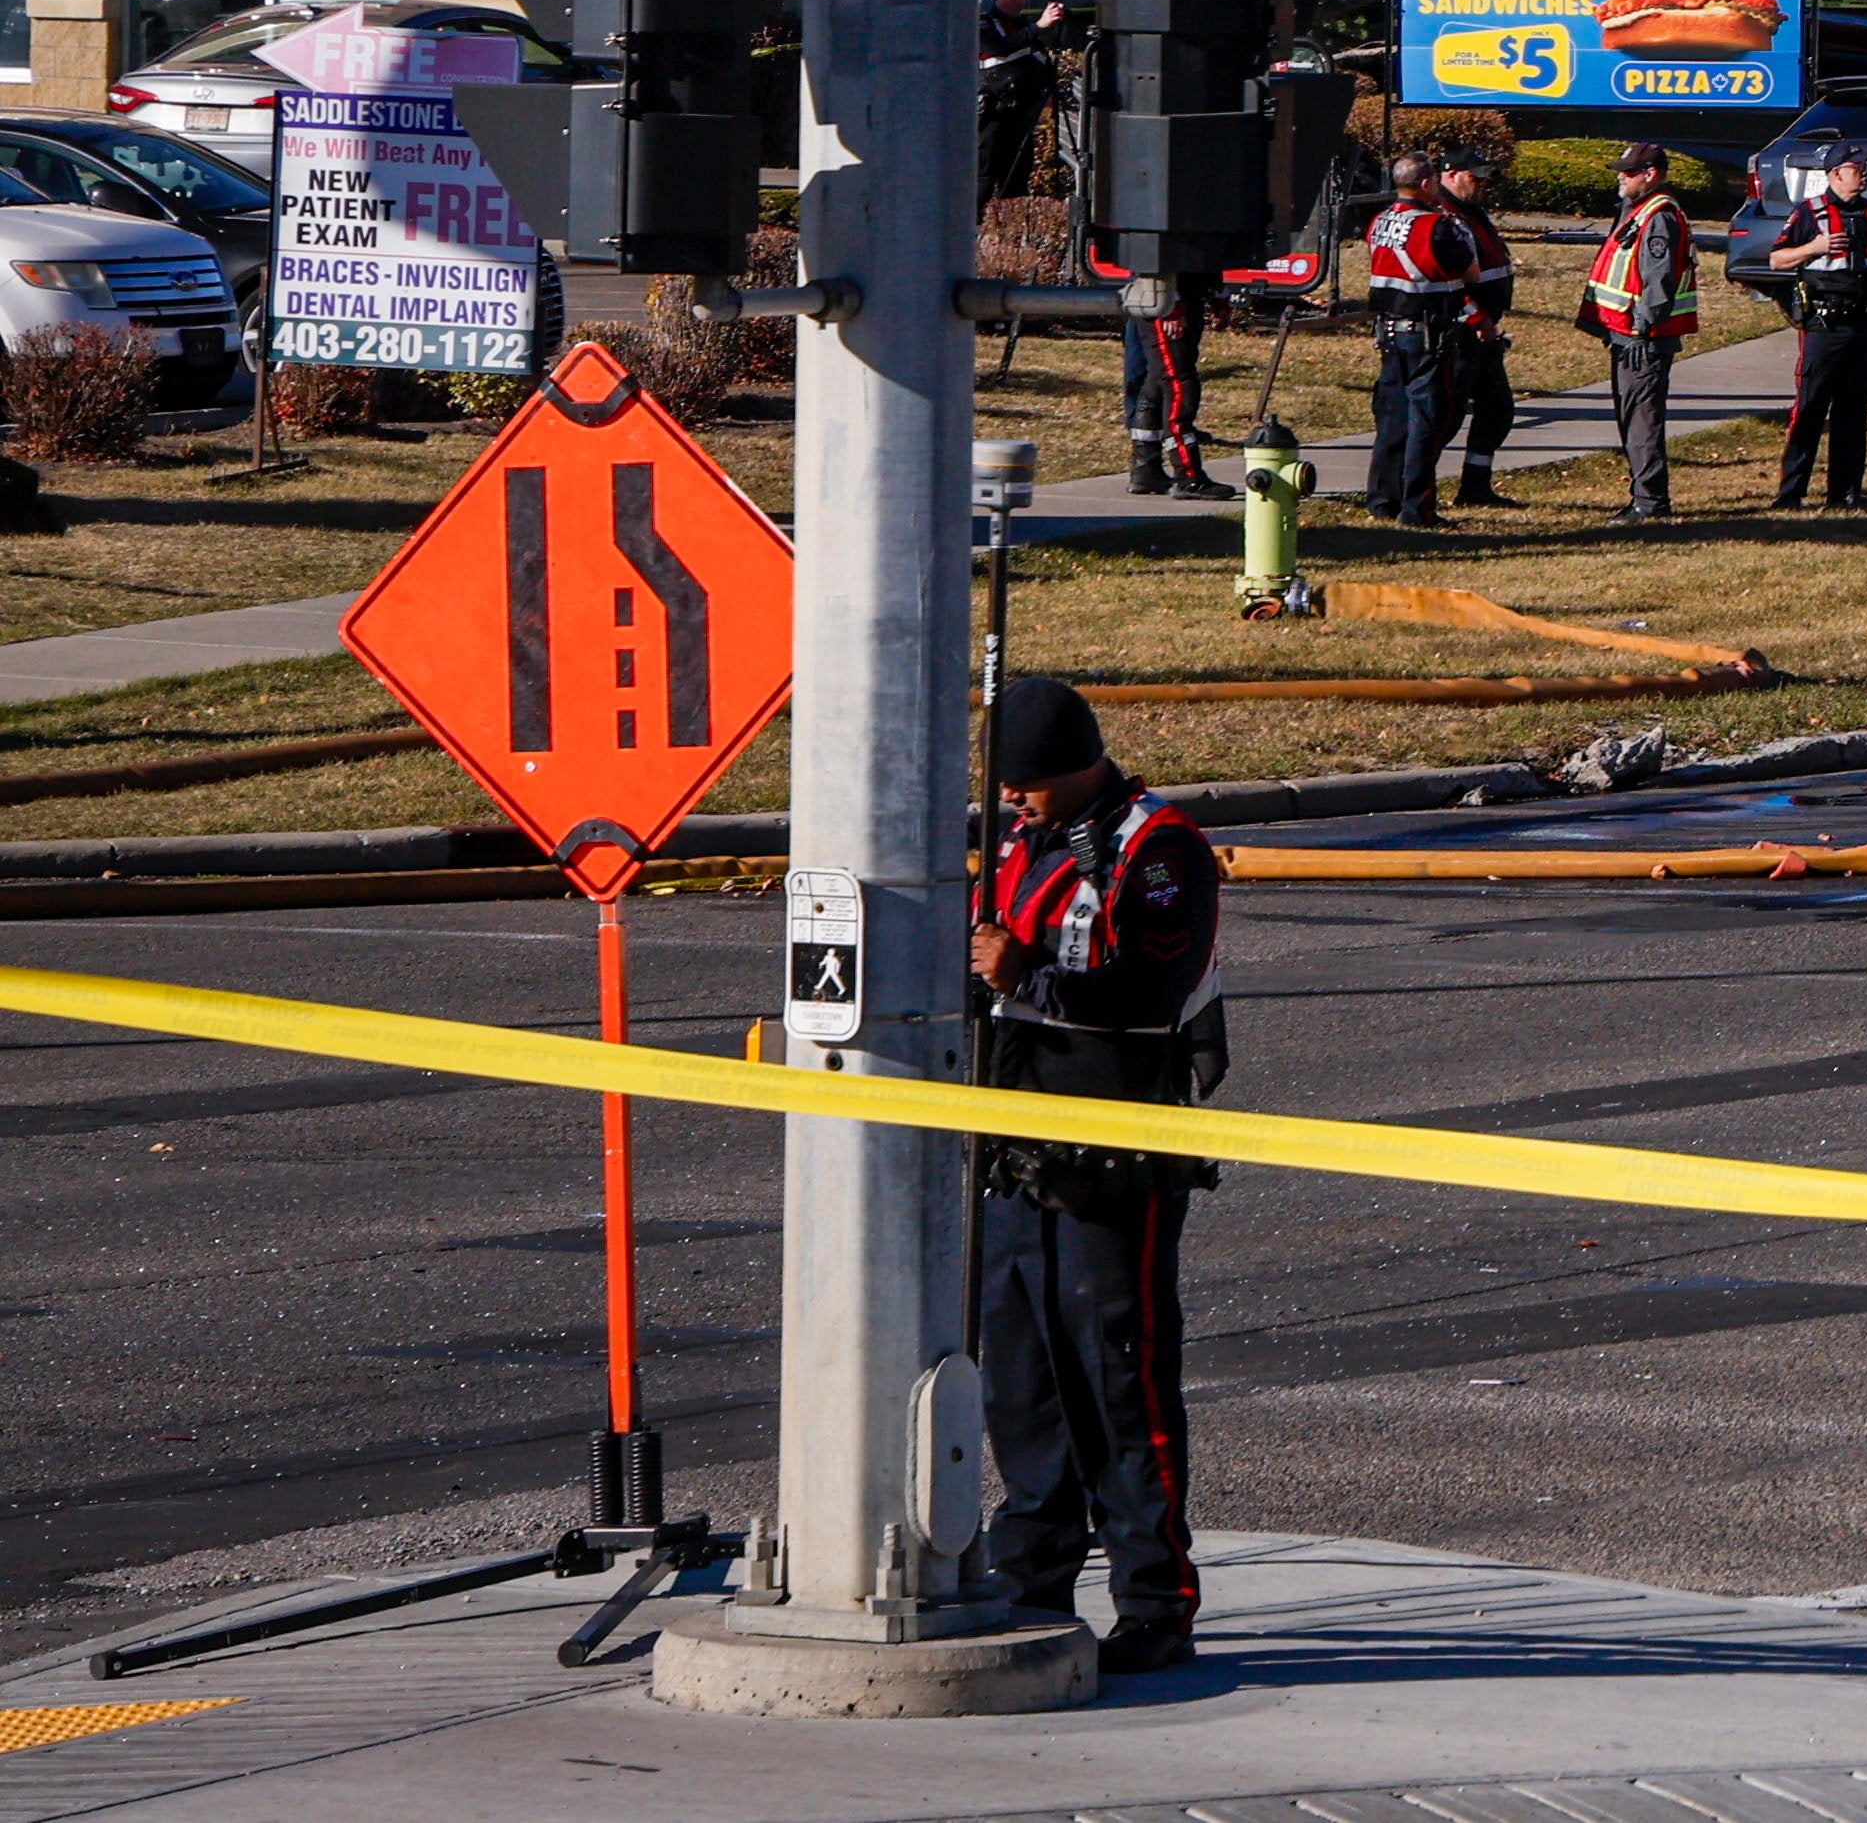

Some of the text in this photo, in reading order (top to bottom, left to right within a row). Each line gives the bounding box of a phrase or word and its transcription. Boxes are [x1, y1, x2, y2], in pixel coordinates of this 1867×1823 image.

[313, 32, 436, 82] FREE
[1499, 35, 1558, 90] $5
[1625, 69, 1764, 95] PIZZA 73
[281, 96, 446, 129] SADDLESTONE
[283, 135, 317, 158] We
[324, 137, 368, 160] Will
[375, 141, 424, 164] Beat
[432, 143, 472, 170] Any
[308, 169, 371, 193] NEW
[281, 195, 396, 221] PATIENT
[296, 223, 378, 248] EXAM
[280, 257, 528, 293] BRACES INVISILIGN
[287, 291, 518, 327] DENTAL IMPLANTS
[272, 321, 526, 369] 403-280-1122
[983, 650, 998, 705] Trimble
